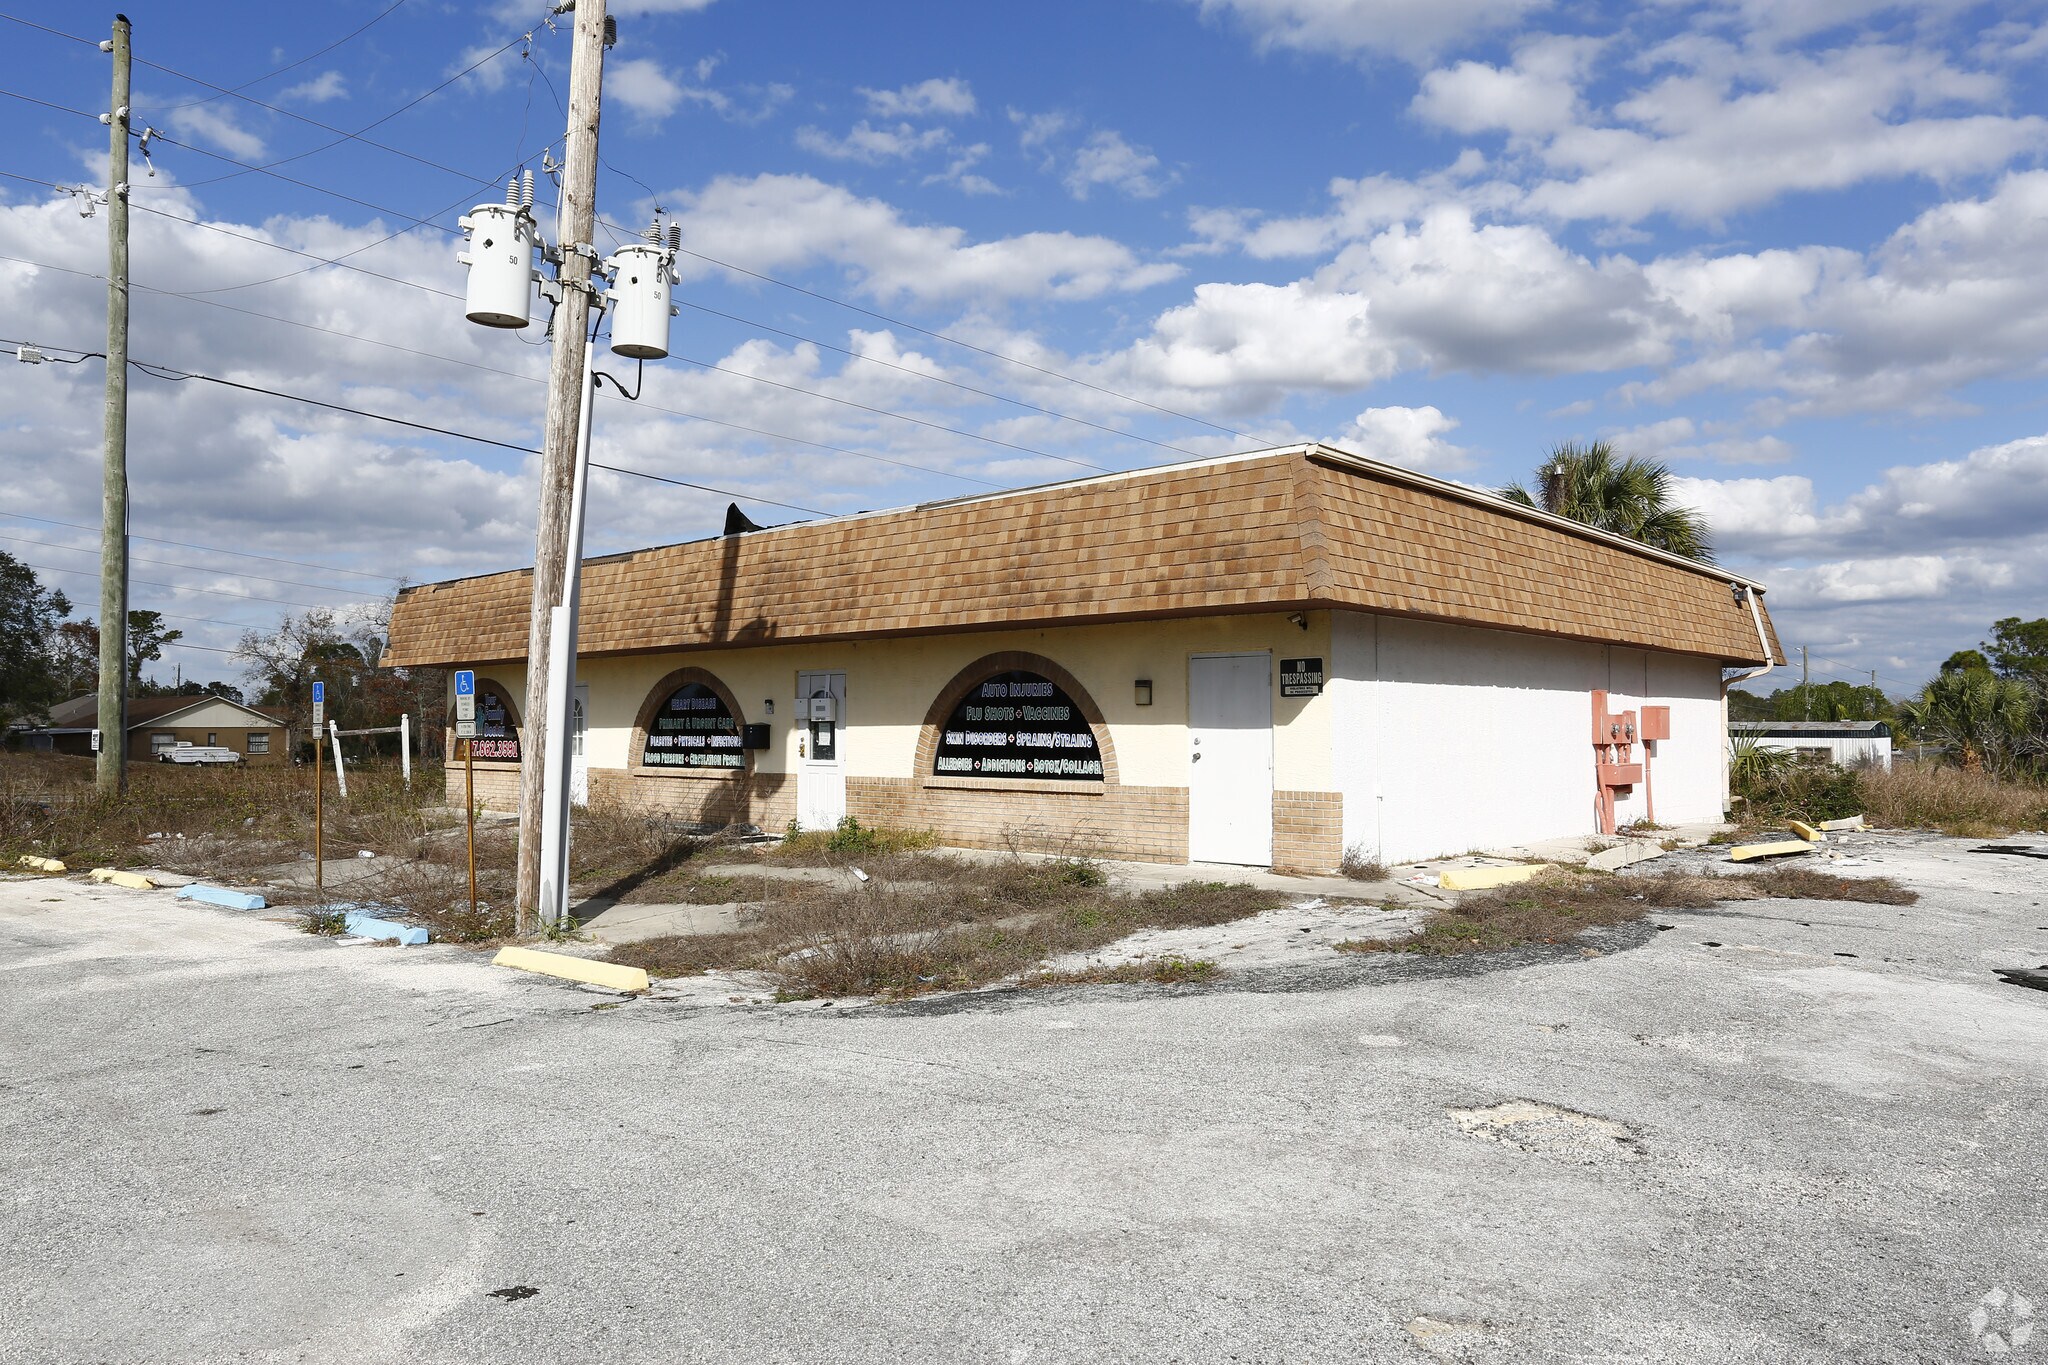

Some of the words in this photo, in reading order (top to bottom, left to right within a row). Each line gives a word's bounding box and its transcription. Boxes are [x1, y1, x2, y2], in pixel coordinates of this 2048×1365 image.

[509, 255, 518, 266] 50
[653, 291, 662, 301] 50
[1296, 661, 1306, 673] NO
[1281, 672, 1322, 685] TRESPASSING
